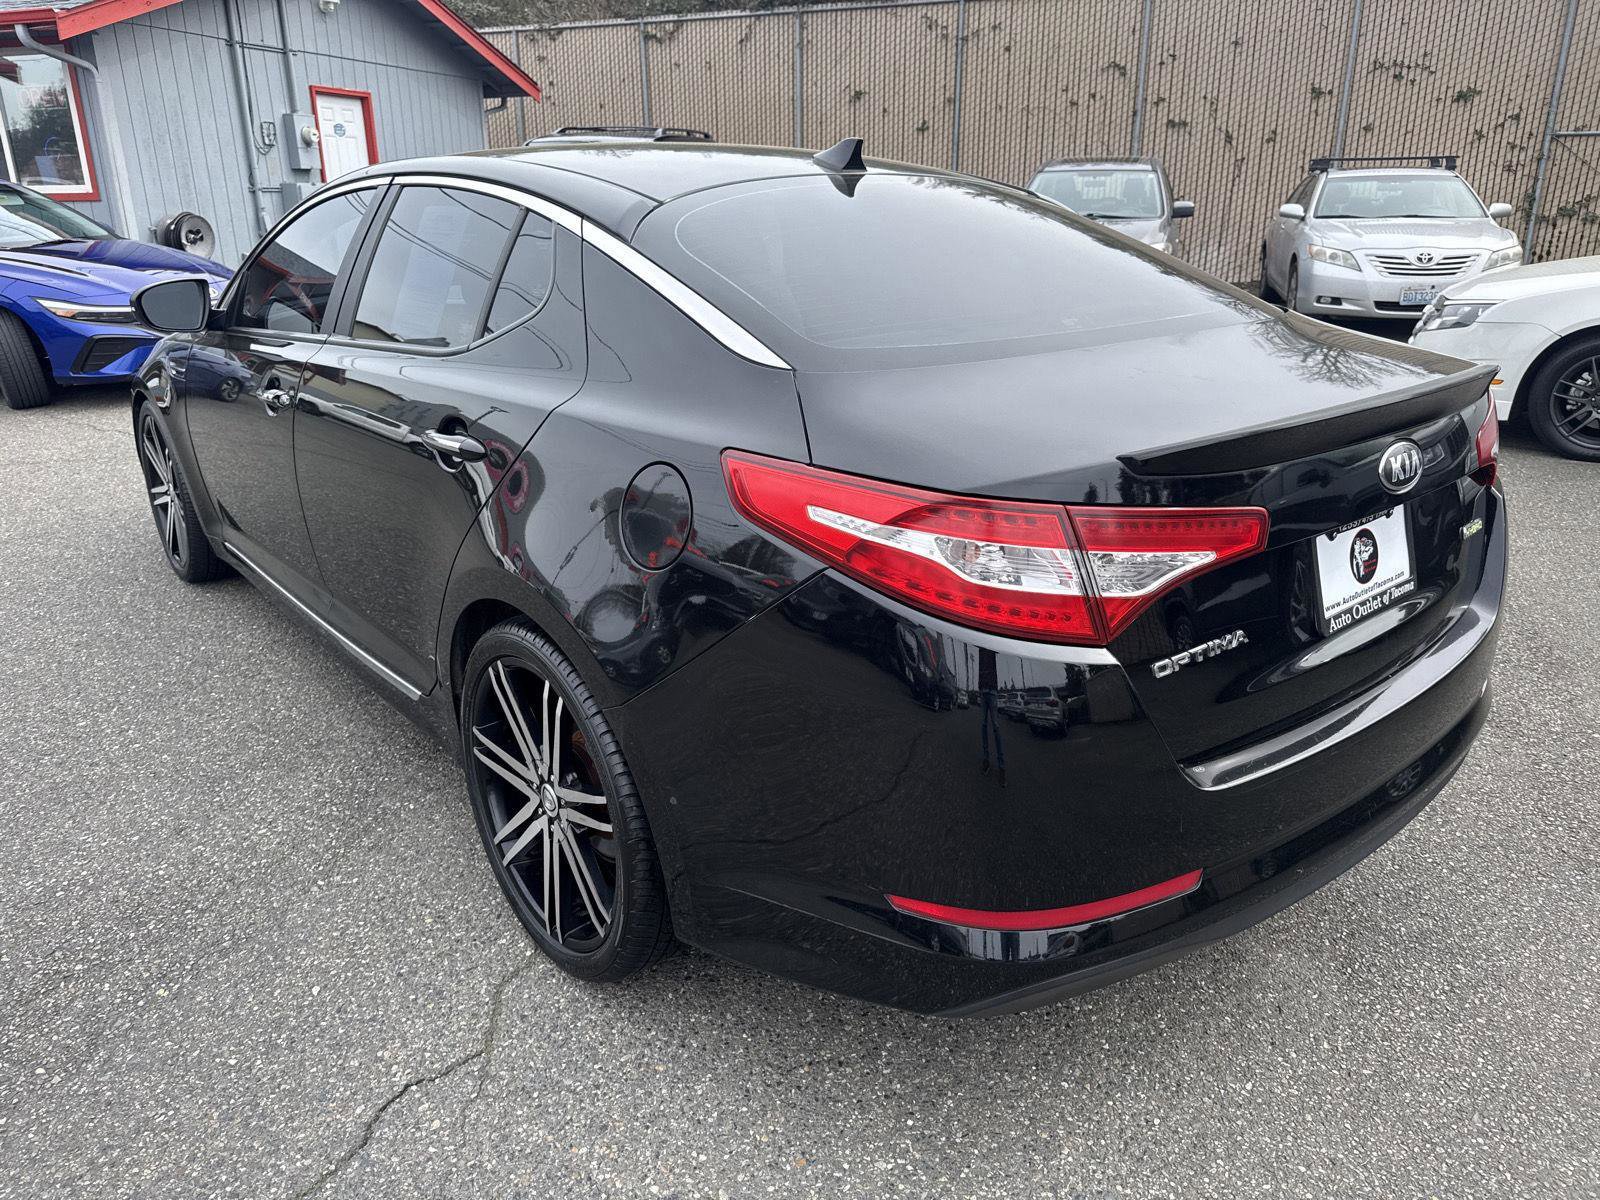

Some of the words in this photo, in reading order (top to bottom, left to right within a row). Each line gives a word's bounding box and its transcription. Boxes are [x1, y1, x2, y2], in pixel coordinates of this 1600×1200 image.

[1389, 449, 1420, 482] KIA
[1329, 613, 1352, 633] Auto
[1352, 596, 1382, 619] Outlet
[1382, 590, 1390, 605] of
[1390, 581, 1415, 600] Tacoma
[1150, 629, 1249, 679] OPTIMA
